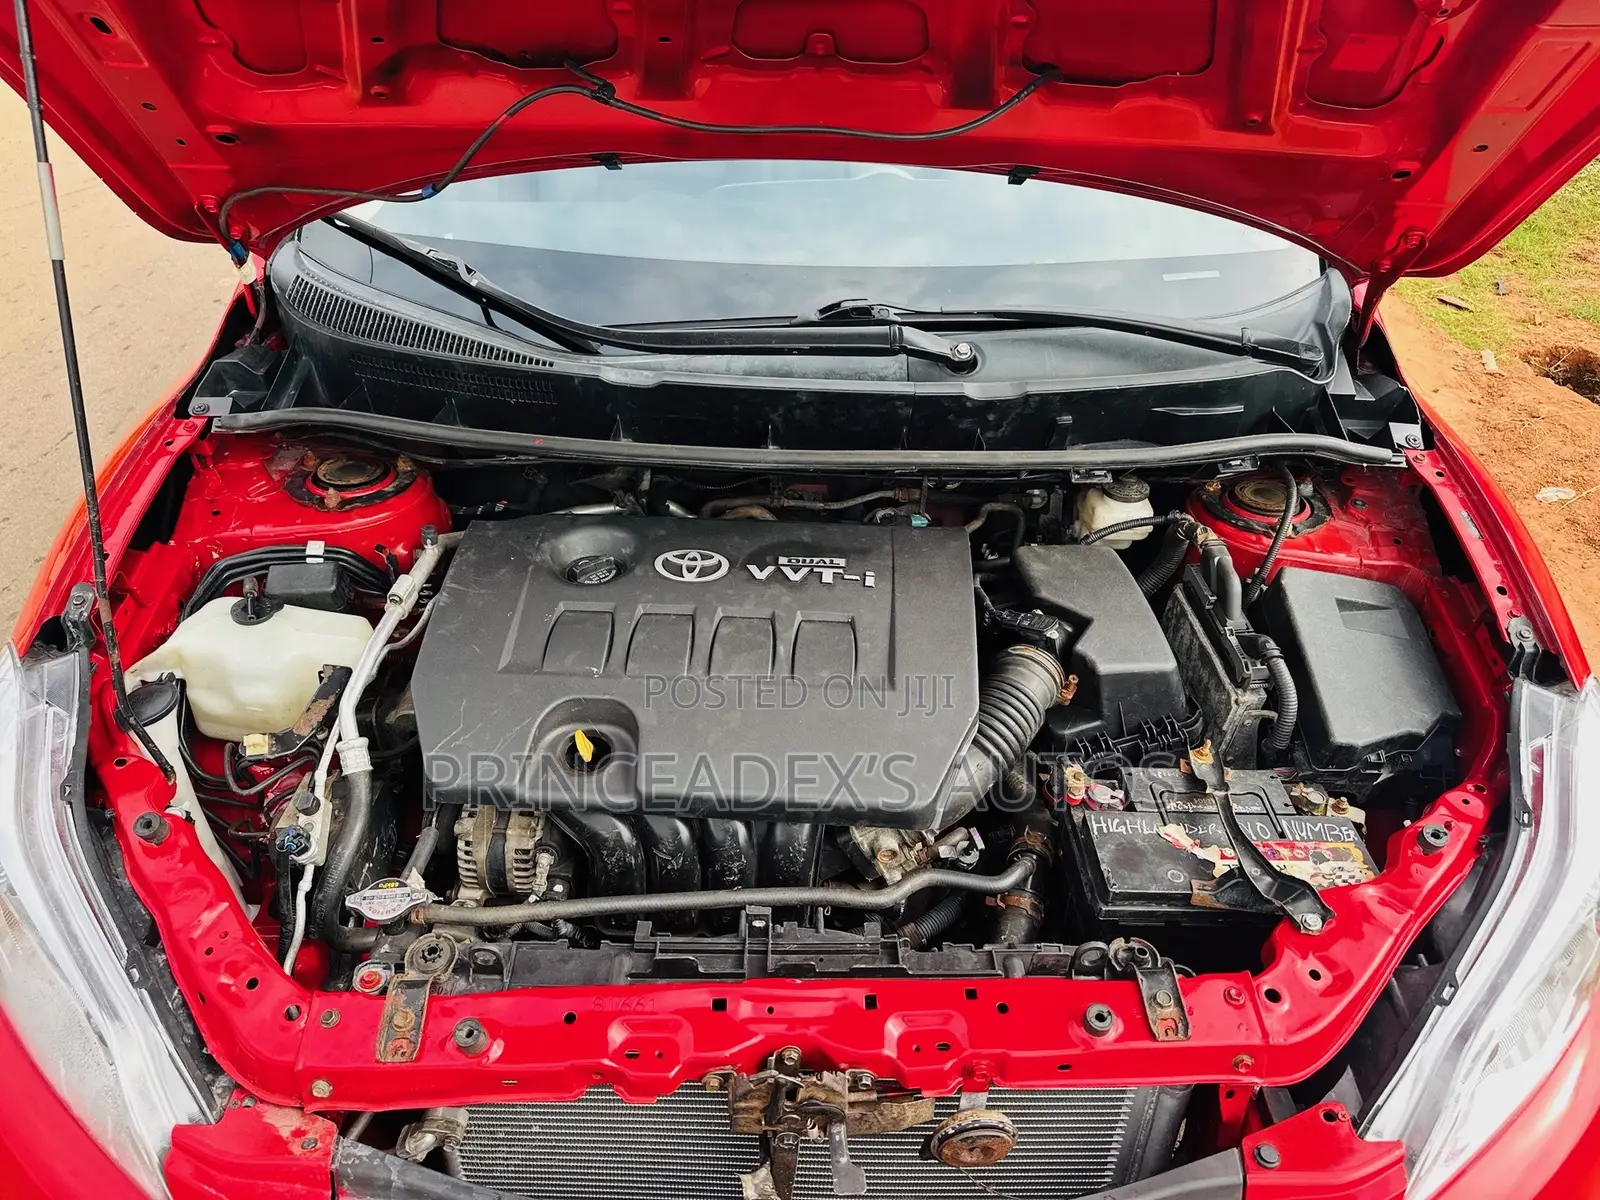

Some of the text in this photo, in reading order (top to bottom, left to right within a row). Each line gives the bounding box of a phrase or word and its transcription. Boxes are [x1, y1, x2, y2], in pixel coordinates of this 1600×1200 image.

[786, 558, 841, 566] DUAL
[746, 564, 876, 588] VVT-i
[1280, 818, 1358, 842] NUMBER
[591, 996, 655, 1013] 81661
